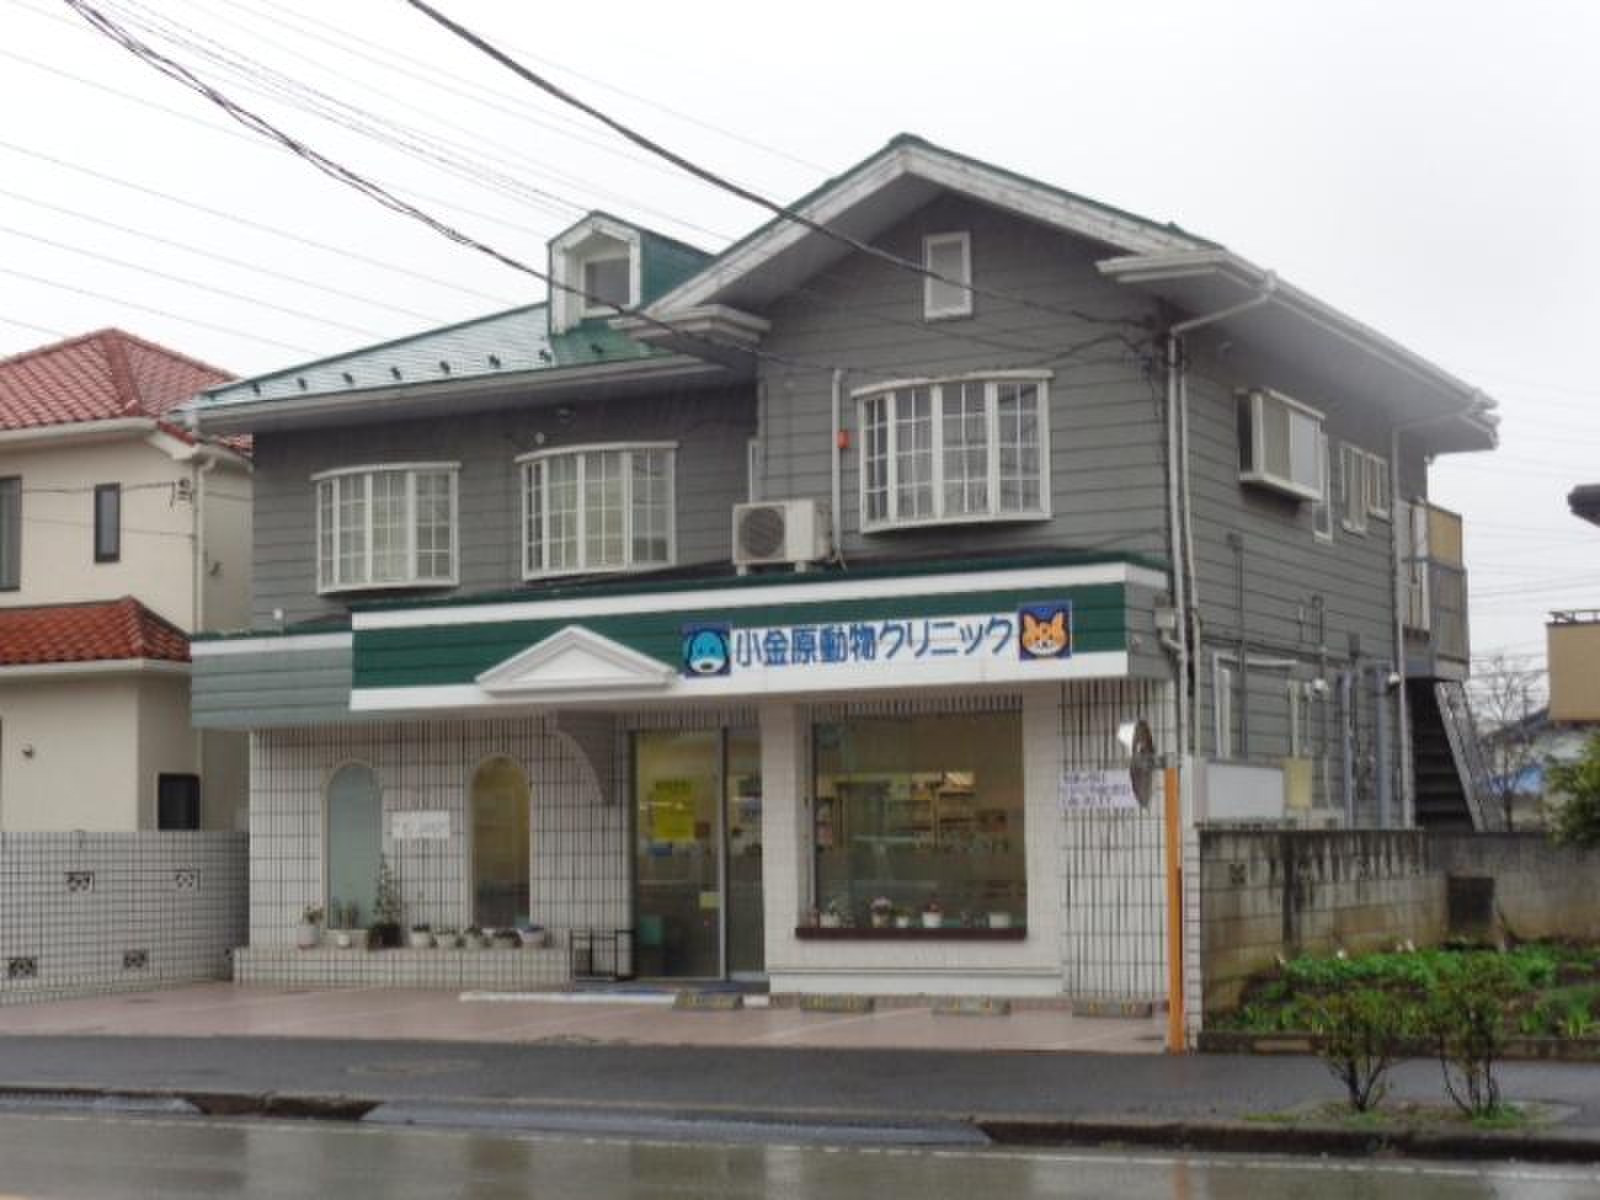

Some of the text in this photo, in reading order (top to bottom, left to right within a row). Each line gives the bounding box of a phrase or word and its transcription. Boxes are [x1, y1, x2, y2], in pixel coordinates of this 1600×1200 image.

[735, 616, 1013, 667] 小金原動物クリニック
